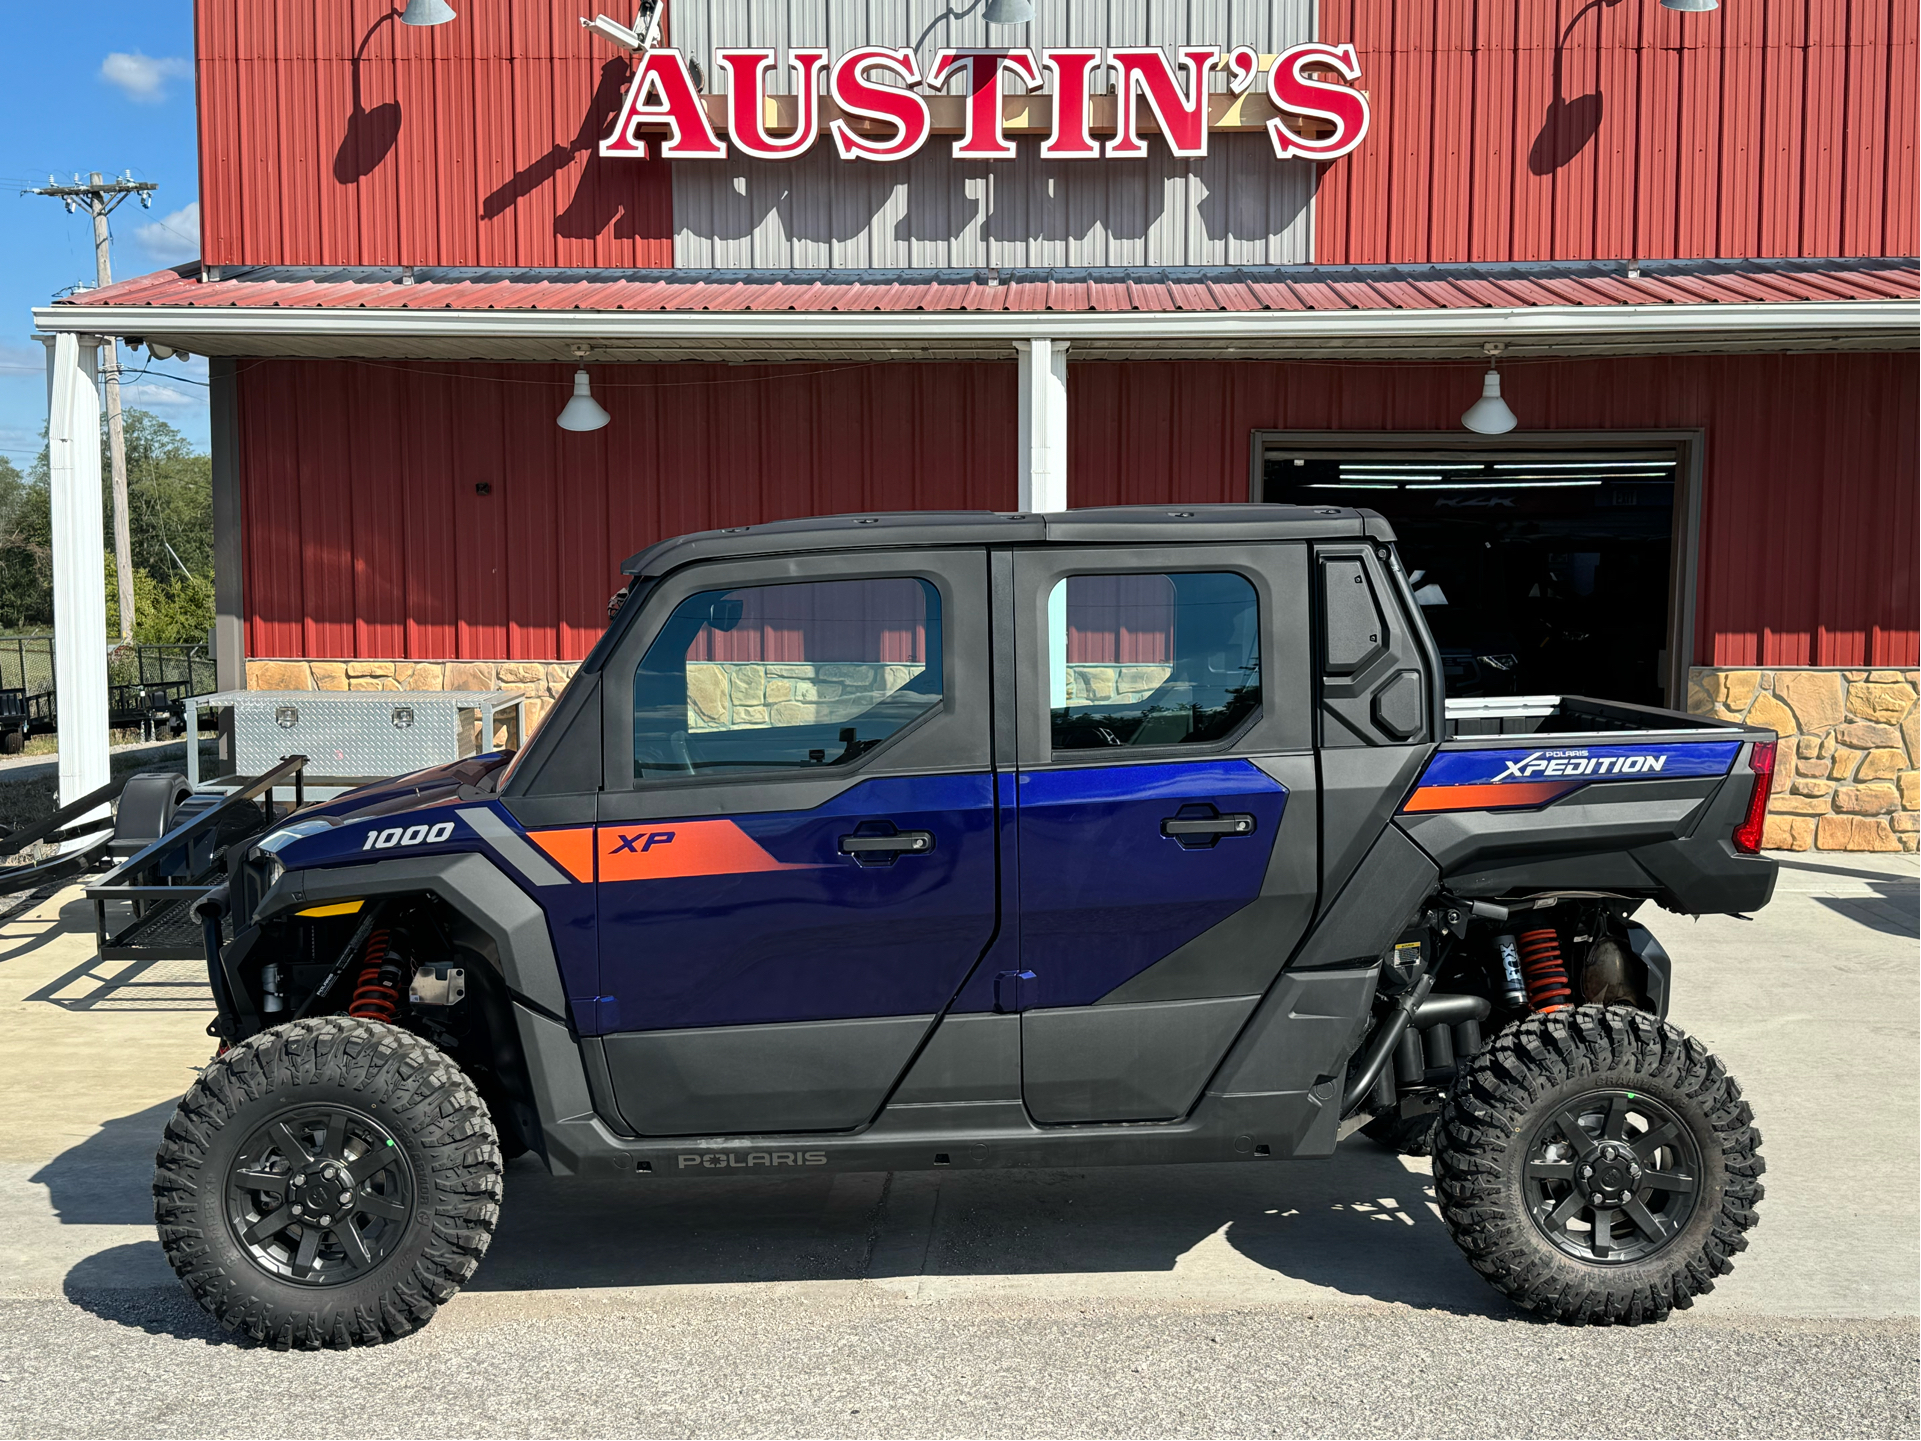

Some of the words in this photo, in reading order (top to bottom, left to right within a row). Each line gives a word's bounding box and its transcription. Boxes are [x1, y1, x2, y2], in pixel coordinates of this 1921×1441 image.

[1491, 751, 1667, 782] XPEDITION
[362, 822, 455, 851] 1000
[607, 831, 676, 855] XP
[1499, 942, 1521, 981] FOX
[390, 1119, 416, 1149] PRO
[409, 1148, 429, 1205] ARMOR
[677, 1151, 828, 1169] POLARIS
